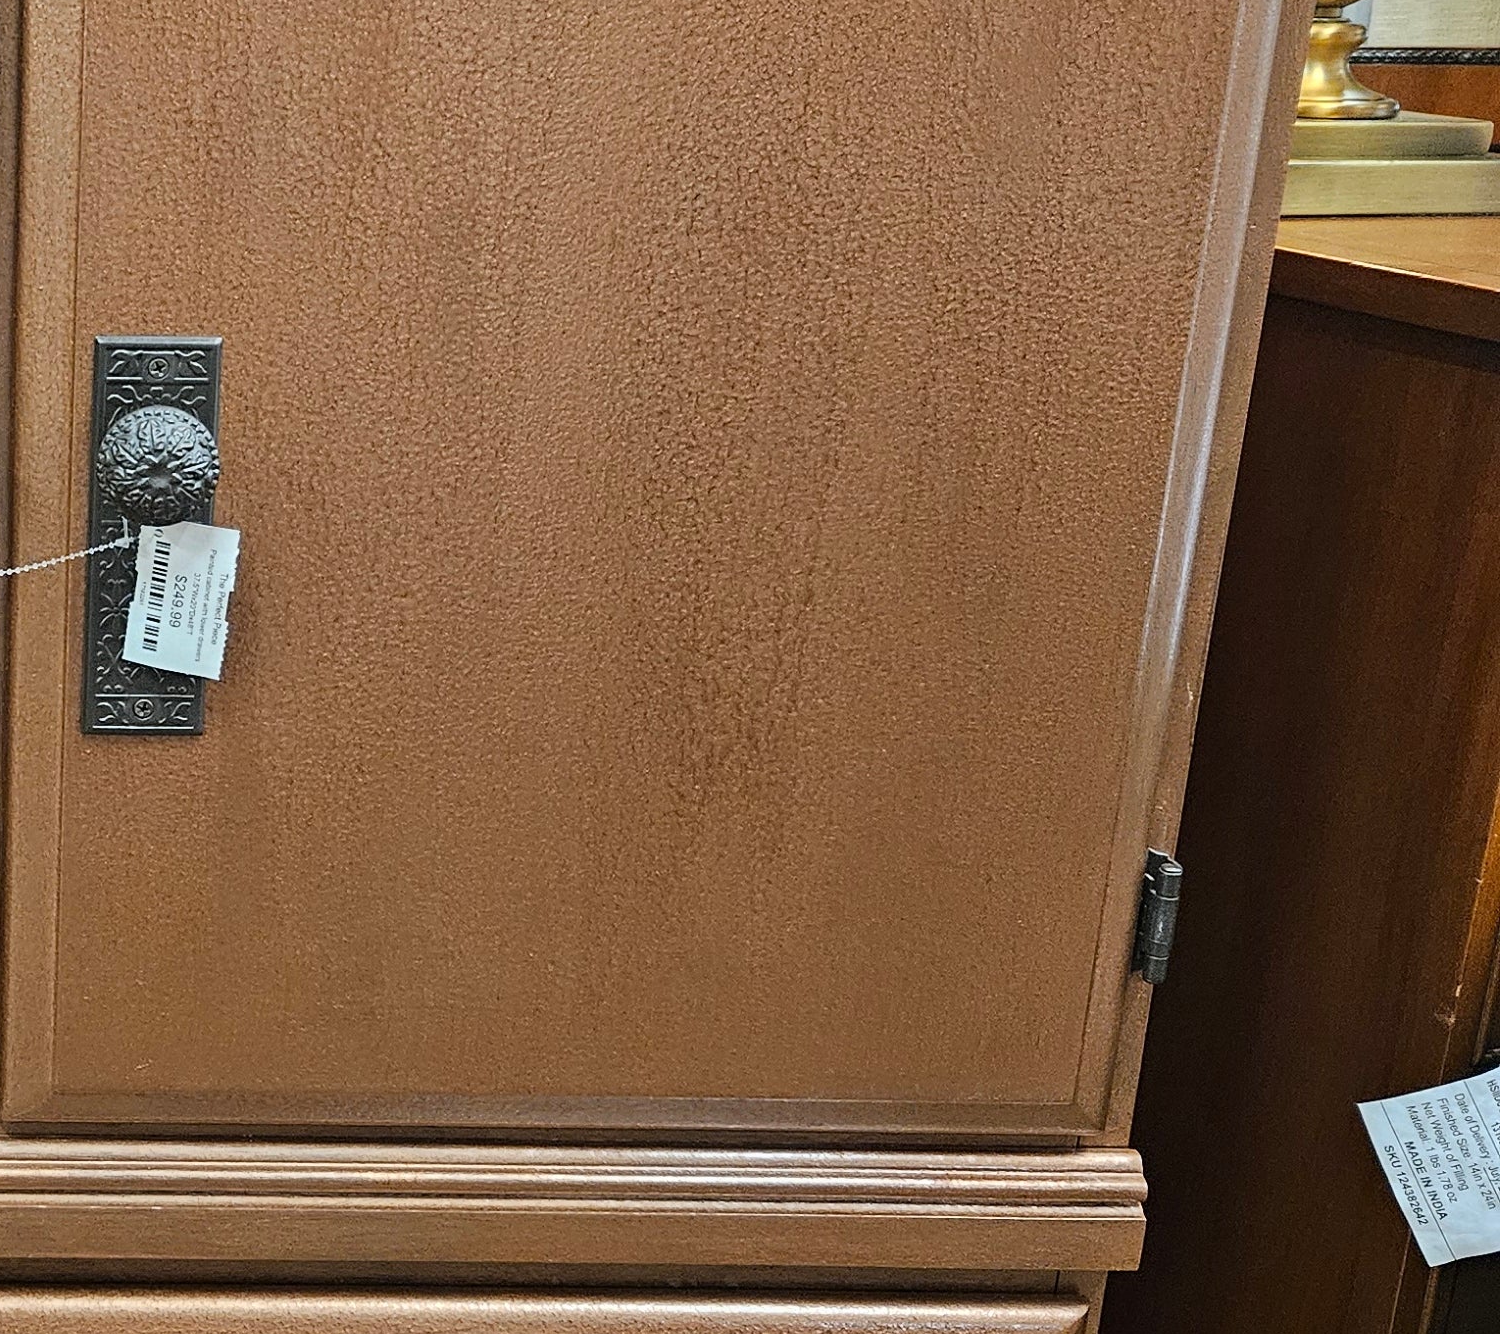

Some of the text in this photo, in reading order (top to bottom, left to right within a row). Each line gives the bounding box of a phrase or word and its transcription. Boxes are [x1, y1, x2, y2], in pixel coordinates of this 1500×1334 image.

[207, 549, 217, 576] Painted
[169, 574, 188, 628] $249.99
[204, 576, 212, 602] cabinet
[211, 573, 229, 645] The Perfect Piece
[195, 636, 204, 662] drawers
[1454, 1093, 1469, 1114] Date
[1464, 1115, 1478, 1124] of
[1421, 1101, 1469, 1192] Net Weight of Filling
[1437, 1097, 1463, 1136] Finished
[1457, 1138, 1473, 1161] Size:
[1468, 1162, 1483, 1182] 14in
[1481, 1189, 1496, 1210] 24in
[1469, 1124, 1491, 1159] Delivery
[1384, 1145, 1429, 1226] SKU 124382642
[1404, 1141, 1448, 1221] MADE IN INDIA
[1429, 1153, 1441, 1169] lbs
[1437, 1170, 1453, 1191] 1.78
[1446, 1191, 1458, 1204] oz
